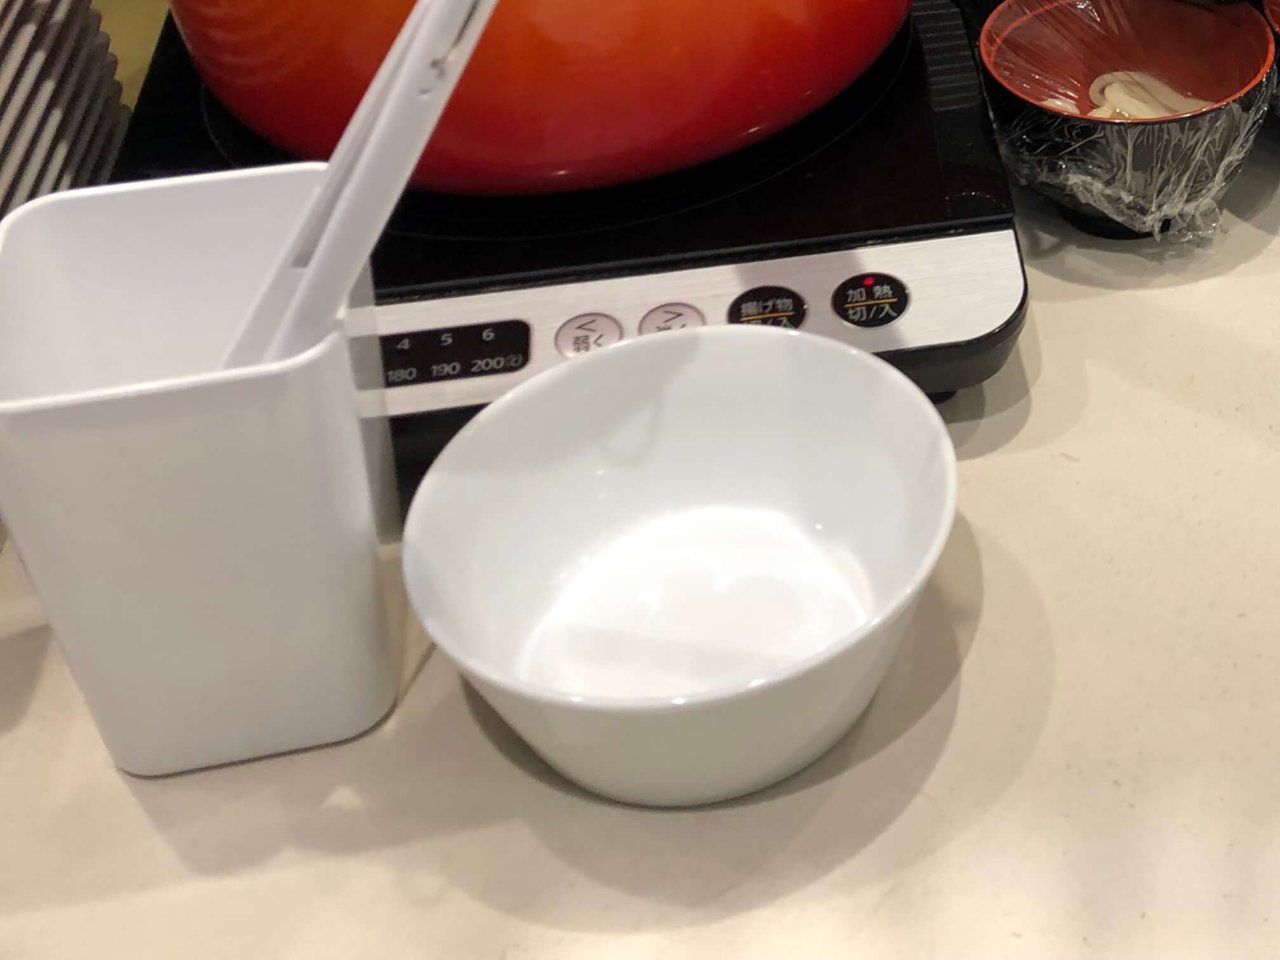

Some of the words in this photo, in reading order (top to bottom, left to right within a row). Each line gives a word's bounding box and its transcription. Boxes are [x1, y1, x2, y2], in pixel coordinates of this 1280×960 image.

[846, 284, 893, 302] 加熱
[847, 304, 898, 322] 切/入
[397, 338, 411, 350] 4
[440, 333, 453, 346] 5
[481, 328, 495, 341] 6
[387, 367, 418, 382] 180
[431, 362, 461, 377] 190
